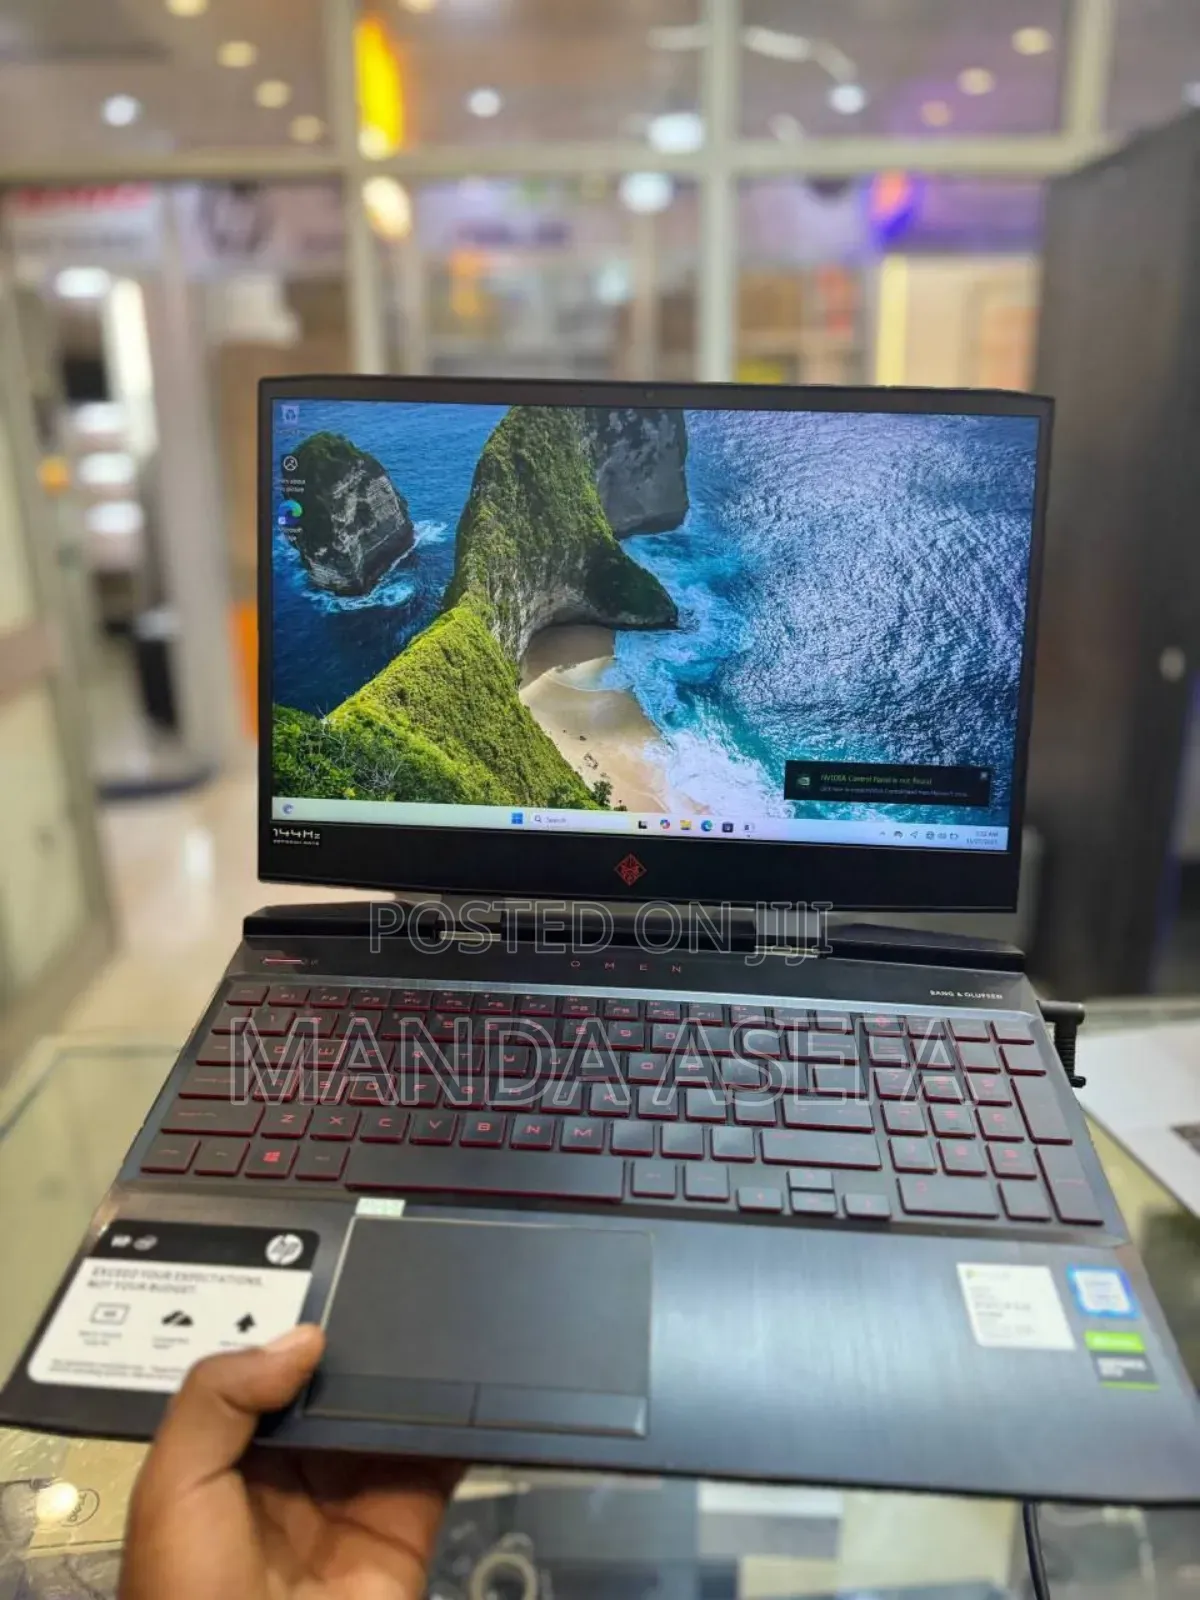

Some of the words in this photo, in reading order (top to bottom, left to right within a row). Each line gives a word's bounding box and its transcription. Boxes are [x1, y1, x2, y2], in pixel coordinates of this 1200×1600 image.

[273, 828, 320, 840] 144Hz
[329, 1116, 344, 1126] X
[378, 1118, 393, 1127] C
[429, 1120, 442, 1129] V
[478, 1122, 491, 1132] B
[526, 1124, 541, 1134] N
[574, 1128, 592, 1138] M
